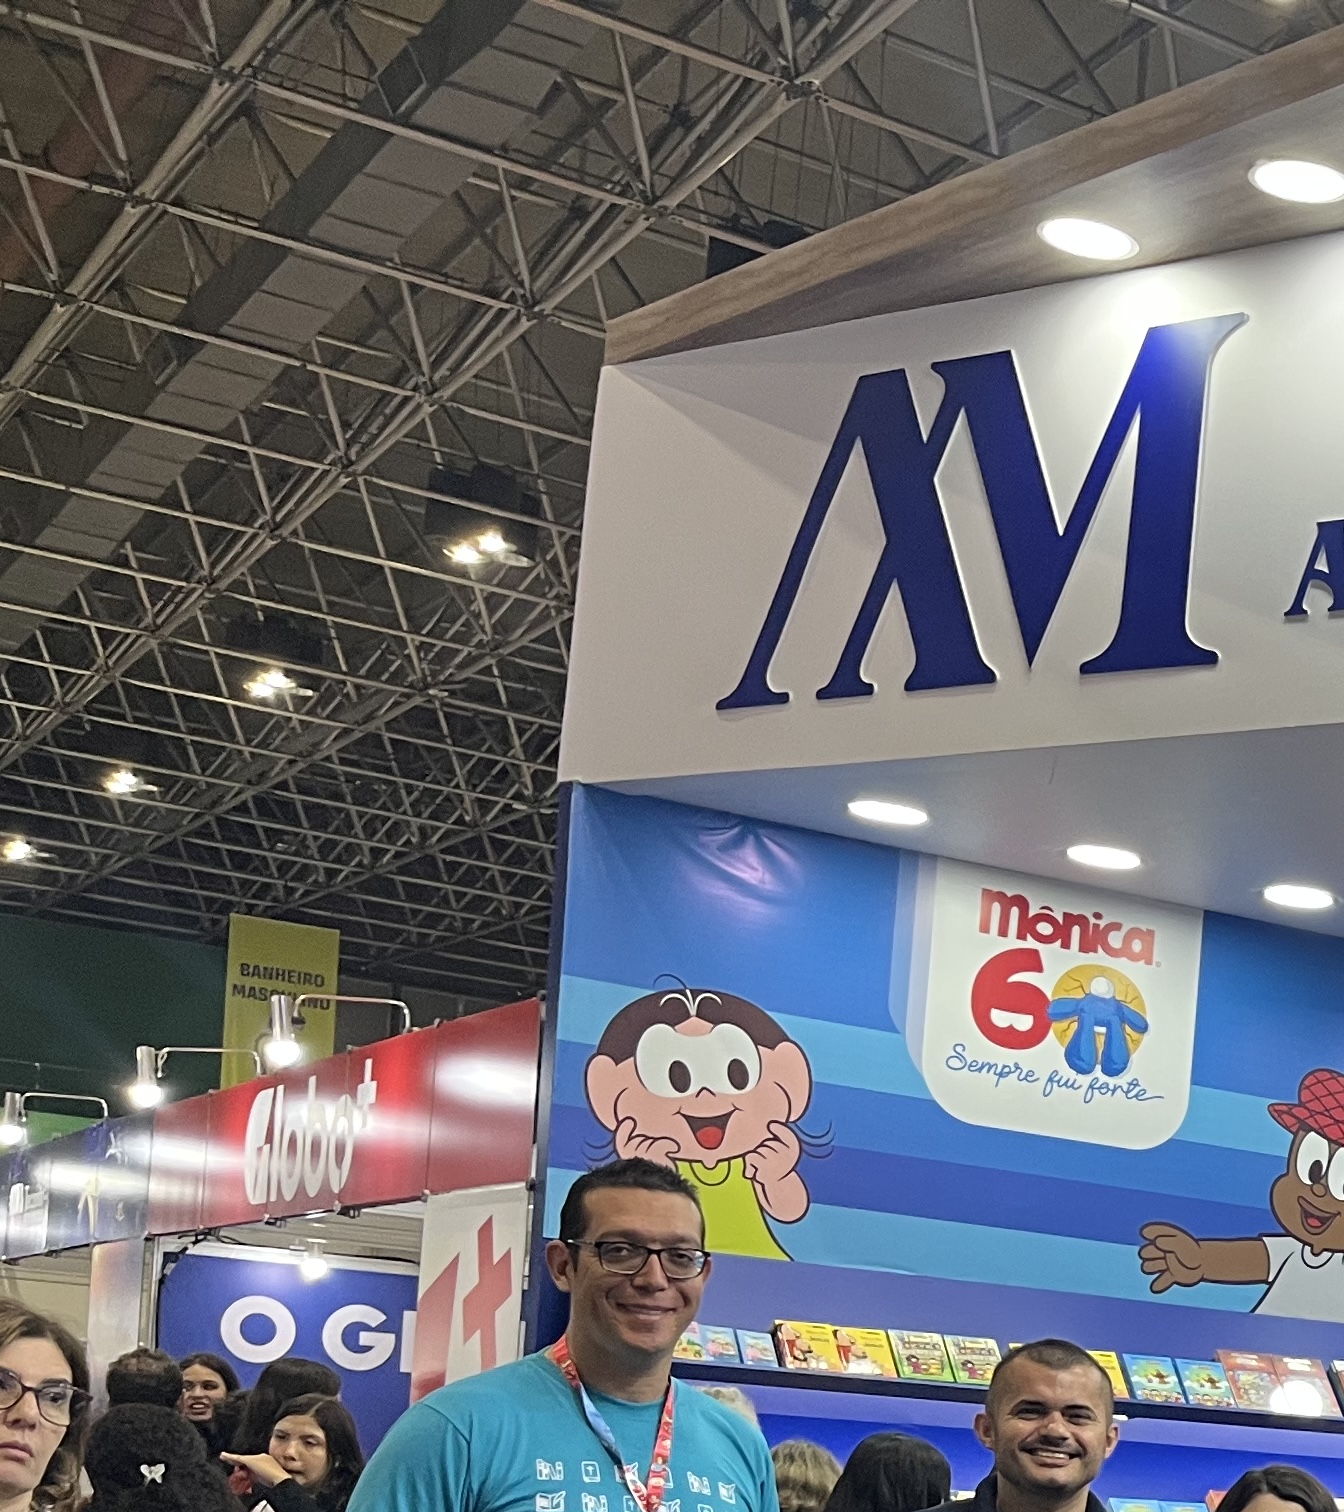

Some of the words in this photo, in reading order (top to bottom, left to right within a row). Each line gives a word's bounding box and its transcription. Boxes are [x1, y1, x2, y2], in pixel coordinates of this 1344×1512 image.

[240, 962, 325, 988] BANHEIRO
[945, 1043, 1040, 1088] Sempre
[1043, 1069, 1082, 1097] fui
[1083, 1077, 1165, 1104] forte
[219, 1295, 297, 1364] O
